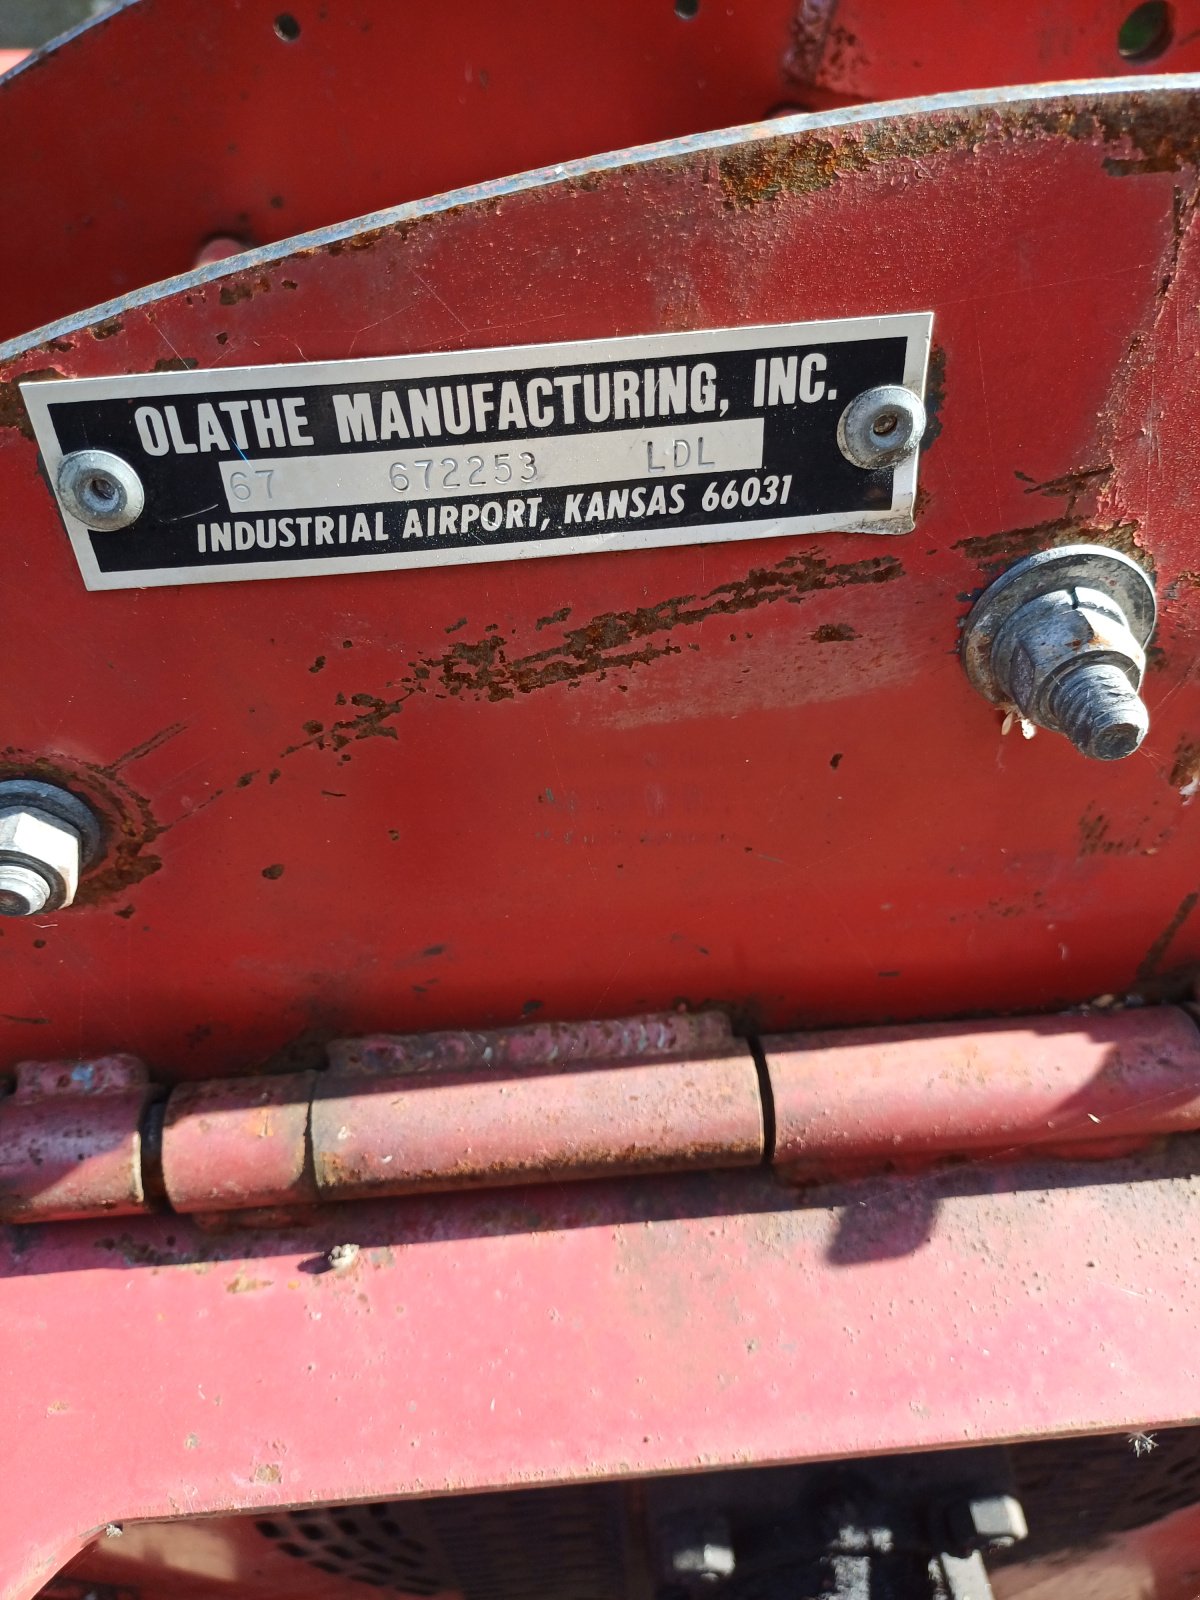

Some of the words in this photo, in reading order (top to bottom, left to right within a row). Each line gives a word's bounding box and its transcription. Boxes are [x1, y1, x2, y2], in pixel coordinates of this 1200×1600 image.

[134, 397, 314, 456] OLATHE
[333, 363, 729, 444] MANUFACTURING,
[753, 353, 837, 407] INC.
[229, 470, 278, 502] 67
[389, 451, 539, 494] 672253
[646, 437, 716, 473] LDL
[197, 512, 388, 553] INDUSTRIAL
[402, 496, 550, 539] AIRPORT,
[563, 483, 686, 525] KANSAS
[701, 474, 793, 511] 66031
